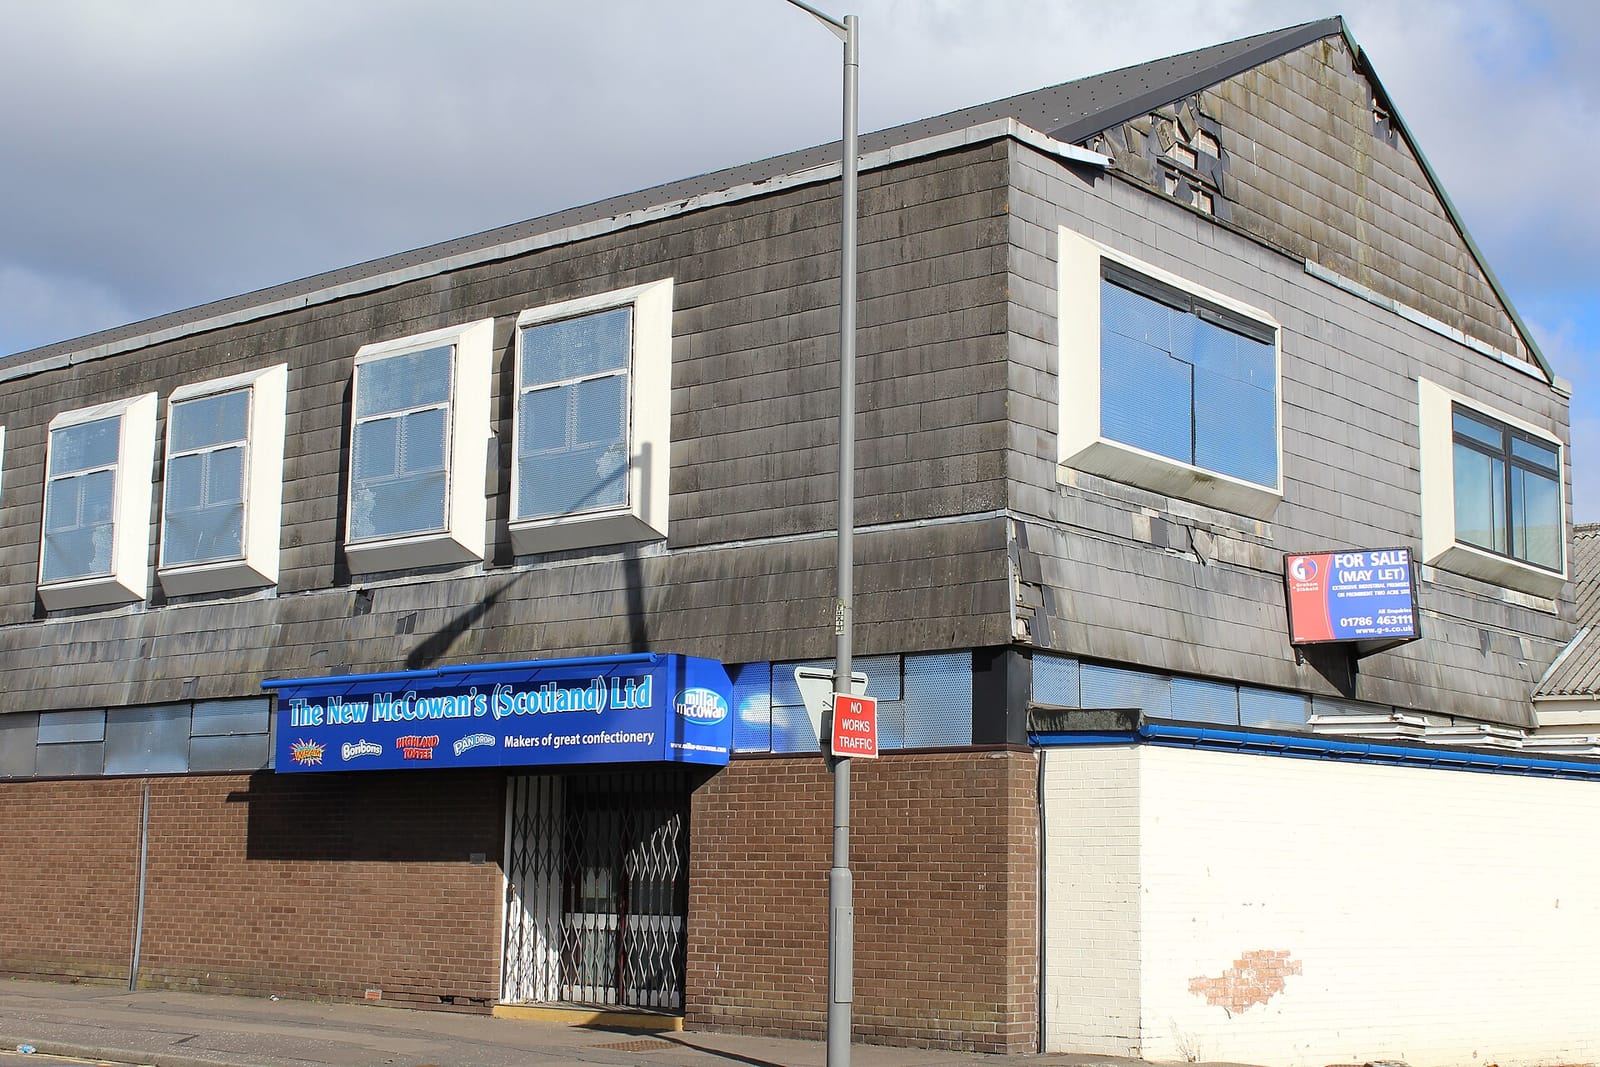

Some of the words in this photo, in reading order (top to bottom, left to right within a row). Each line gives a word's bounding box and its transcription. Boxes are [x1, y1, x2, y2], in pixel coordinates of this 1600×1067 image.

[1334, 554, 1365, 569] FOR
[1370, 550, 1409, 567] SALE
[1338, 569, 1373, 584] (MAY
[1378, 567, 1405, 581] LET)
[1340, 616, 1373, 628] 01786
[1376, 614, 1413, 626] 463111
[1355, 625, 1414, 635] www.g-s.co.uk
[289, 698, 324, 727] The
[326, 695, 369, 725] New
[371, 686, 488, 723] McCowan's
[491, 674, 608, 721] (Scotland)
[609, 674, 653, 711] Ltd
[684, 690, 719, 706] millar
[850, 701, 862, 714] NO
[841, 718, 870, 733] WORKS
[396, 735, 440, 750] HIGHLAND
[453, 738, 475, 756] PAN
[473, 733, 496, 746] DROPS
[504, 736, 540, 748] Makers
[541, 733, 553, 747] of
[553, 735, 580, 750] great
[582, 731, 655, 746] confectionery
[839, 735, 873, 751] TRAFFIC
[342, 739, 383, 761] Bonbons
[403, 747, 433, 761] TOFFEE
